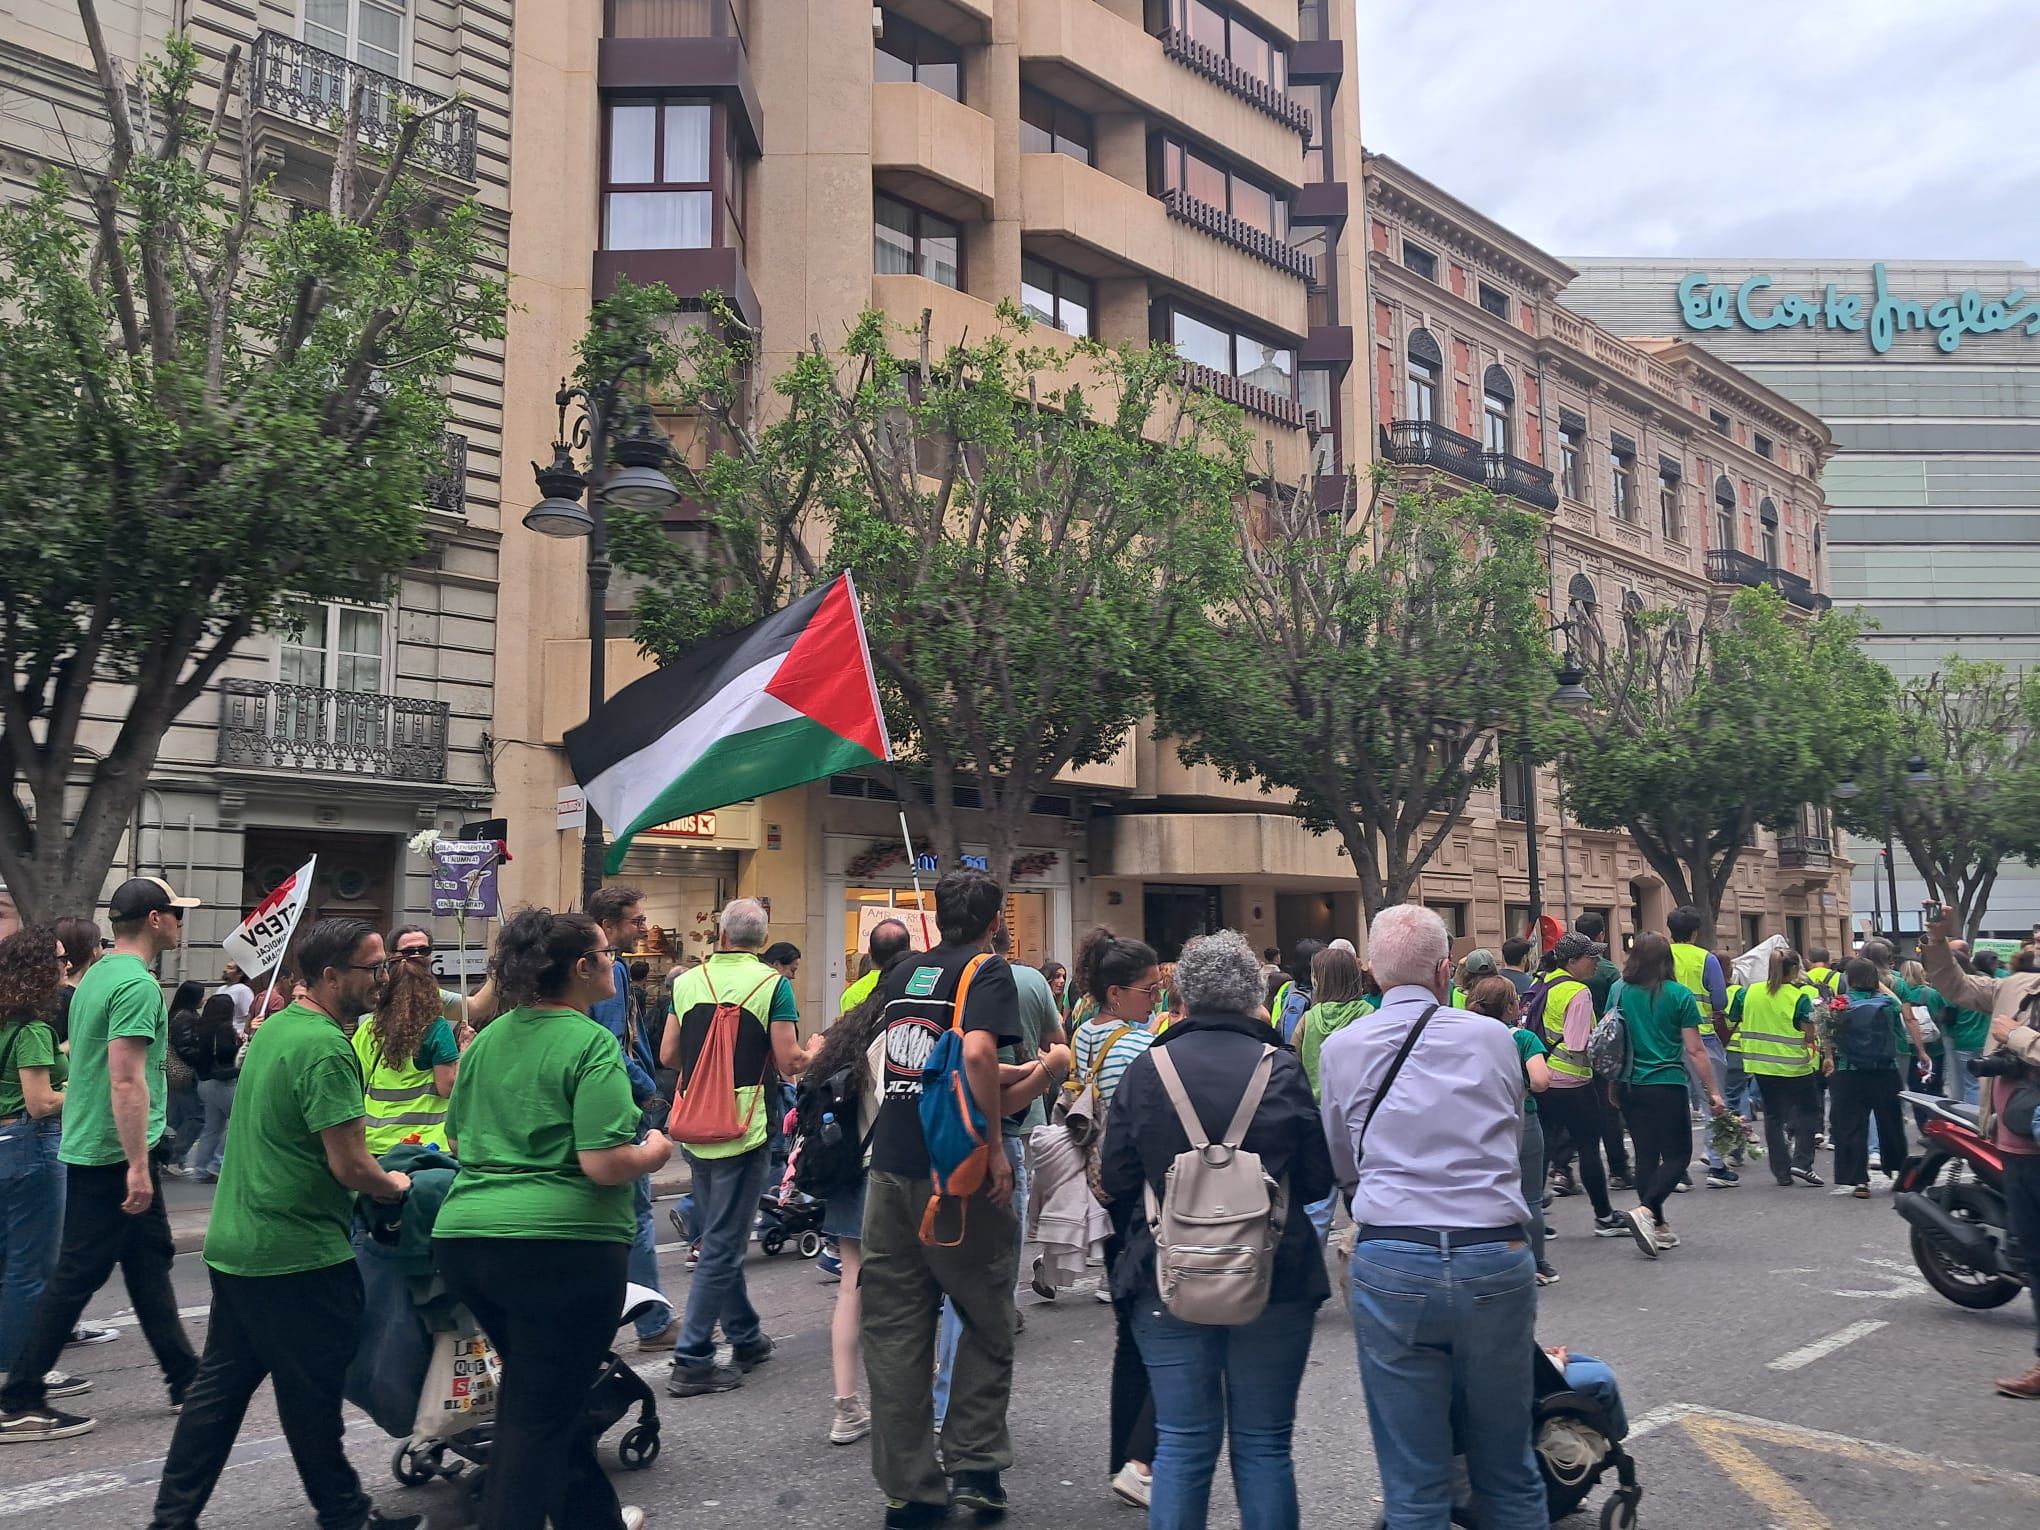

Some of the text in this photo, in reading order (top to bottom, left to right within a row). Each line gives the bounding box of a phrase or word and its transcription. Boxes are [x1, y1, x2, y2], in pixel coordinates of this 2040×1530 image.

[1678, 262, 2040, 353] El Corte Inglés
